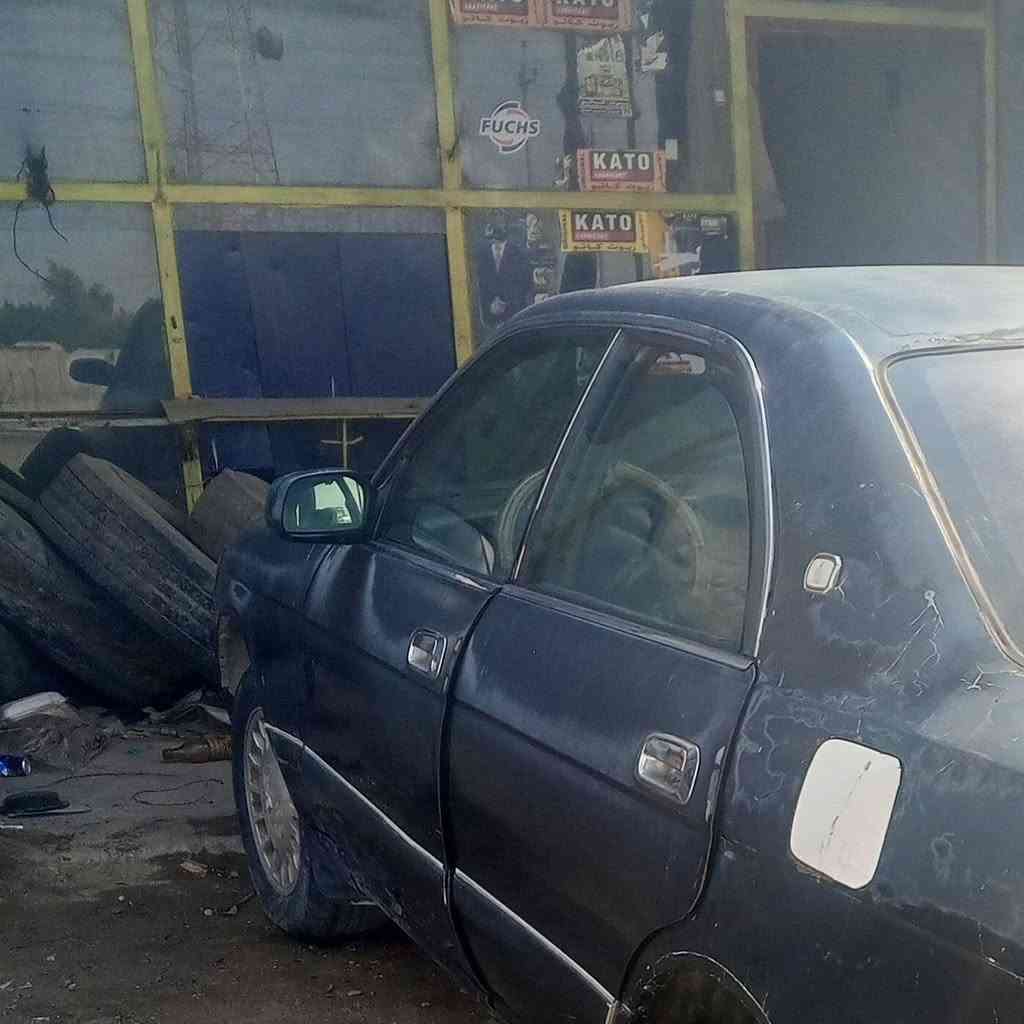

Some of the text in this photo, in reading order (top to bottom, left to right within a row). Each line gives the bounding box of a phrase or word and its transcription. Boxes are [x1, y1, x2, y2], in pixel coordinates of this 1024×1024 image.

[481, 119, 539, 135] FUCHS
[593, 152, 650, 170] KATO
[575, 213, 632, 231] KATO
